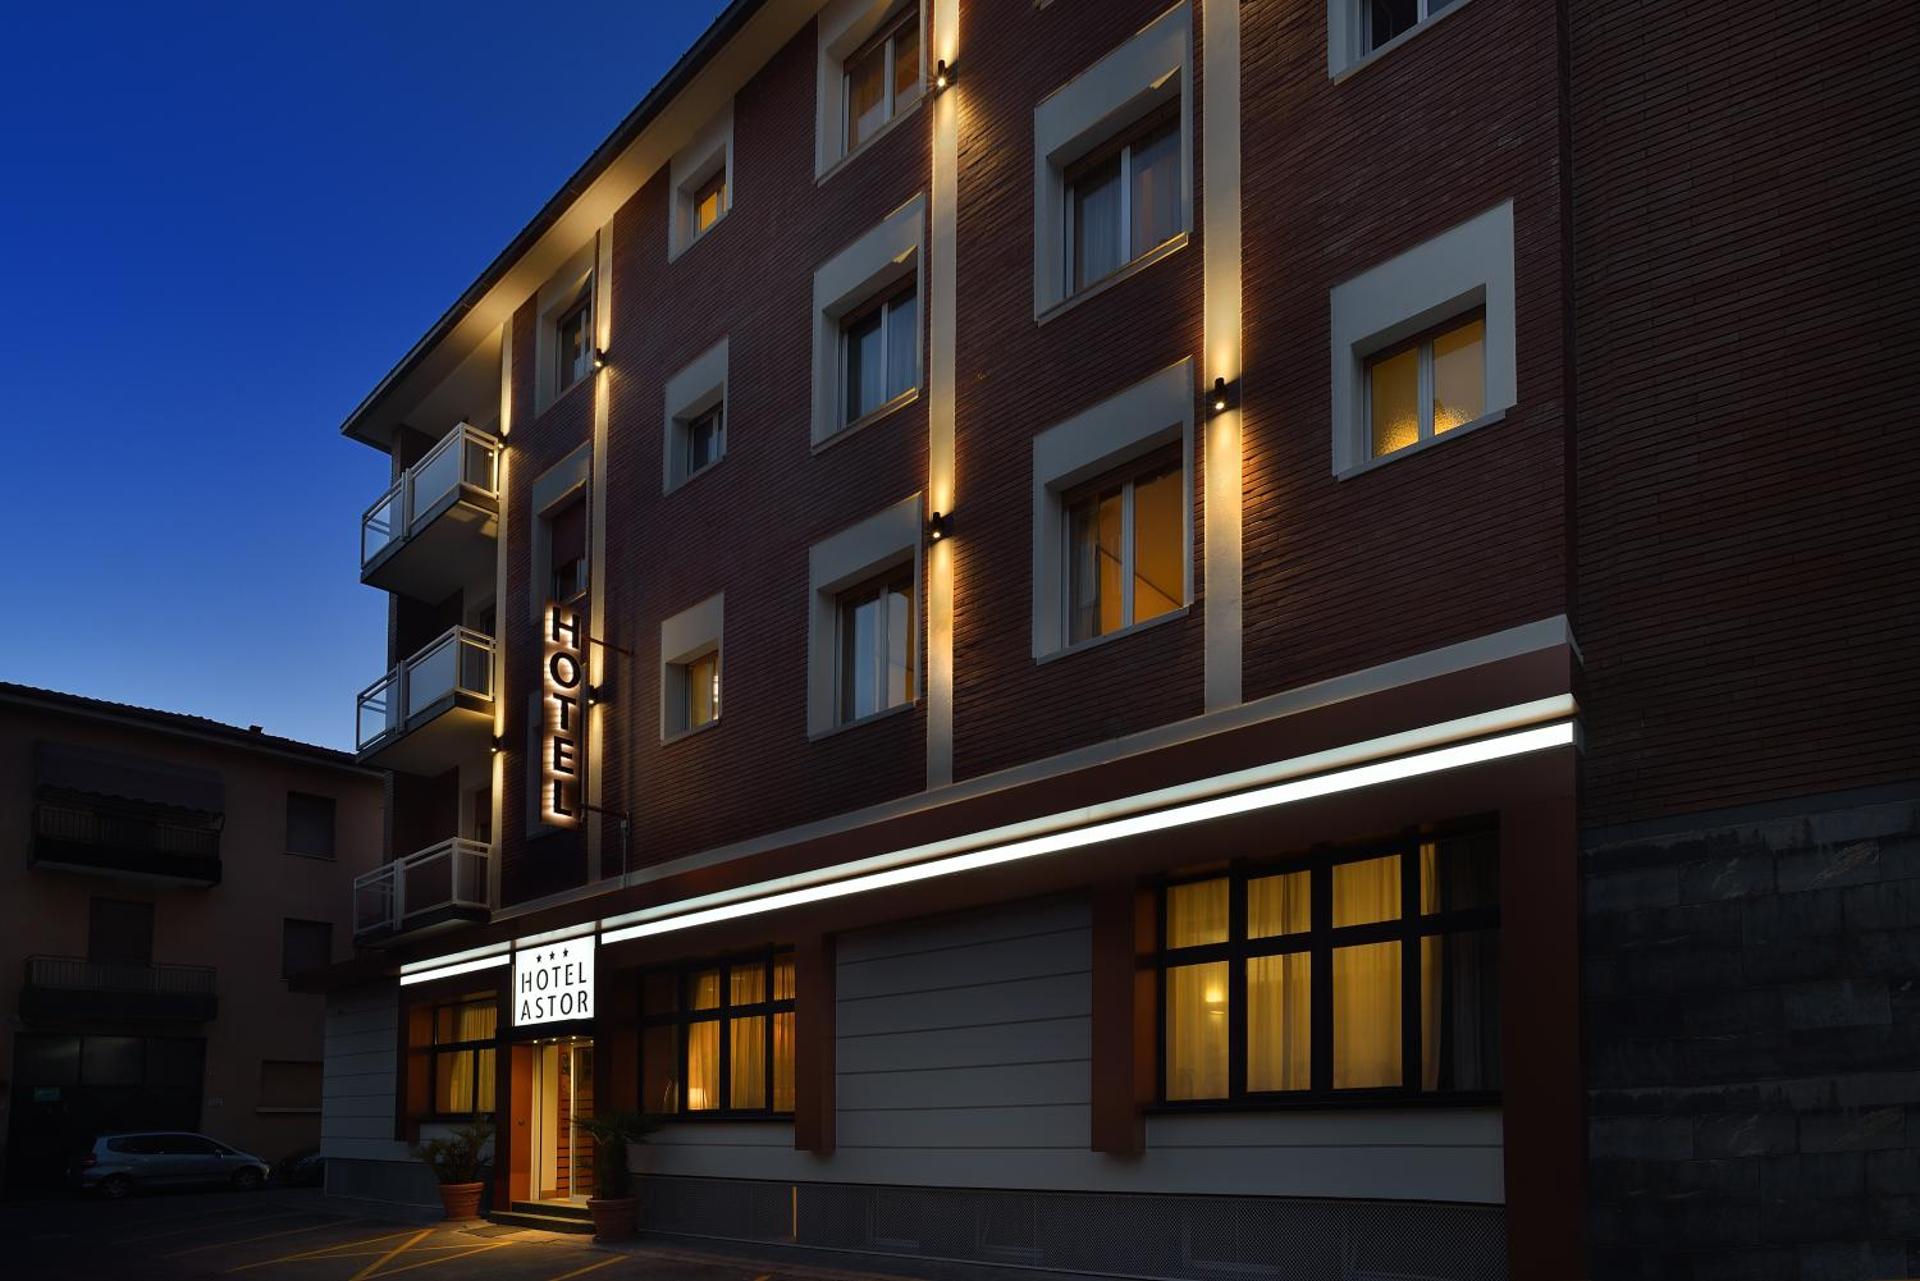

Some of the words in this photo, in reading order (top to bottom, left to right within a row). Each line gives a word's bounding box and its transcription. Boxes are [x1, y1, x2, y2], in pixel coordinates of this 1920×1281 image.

[549, 606, 581, 817] HOTEL
[521, 961, 587, 994] HOTEL
[520, 990, 588, 1021] ASTOR
